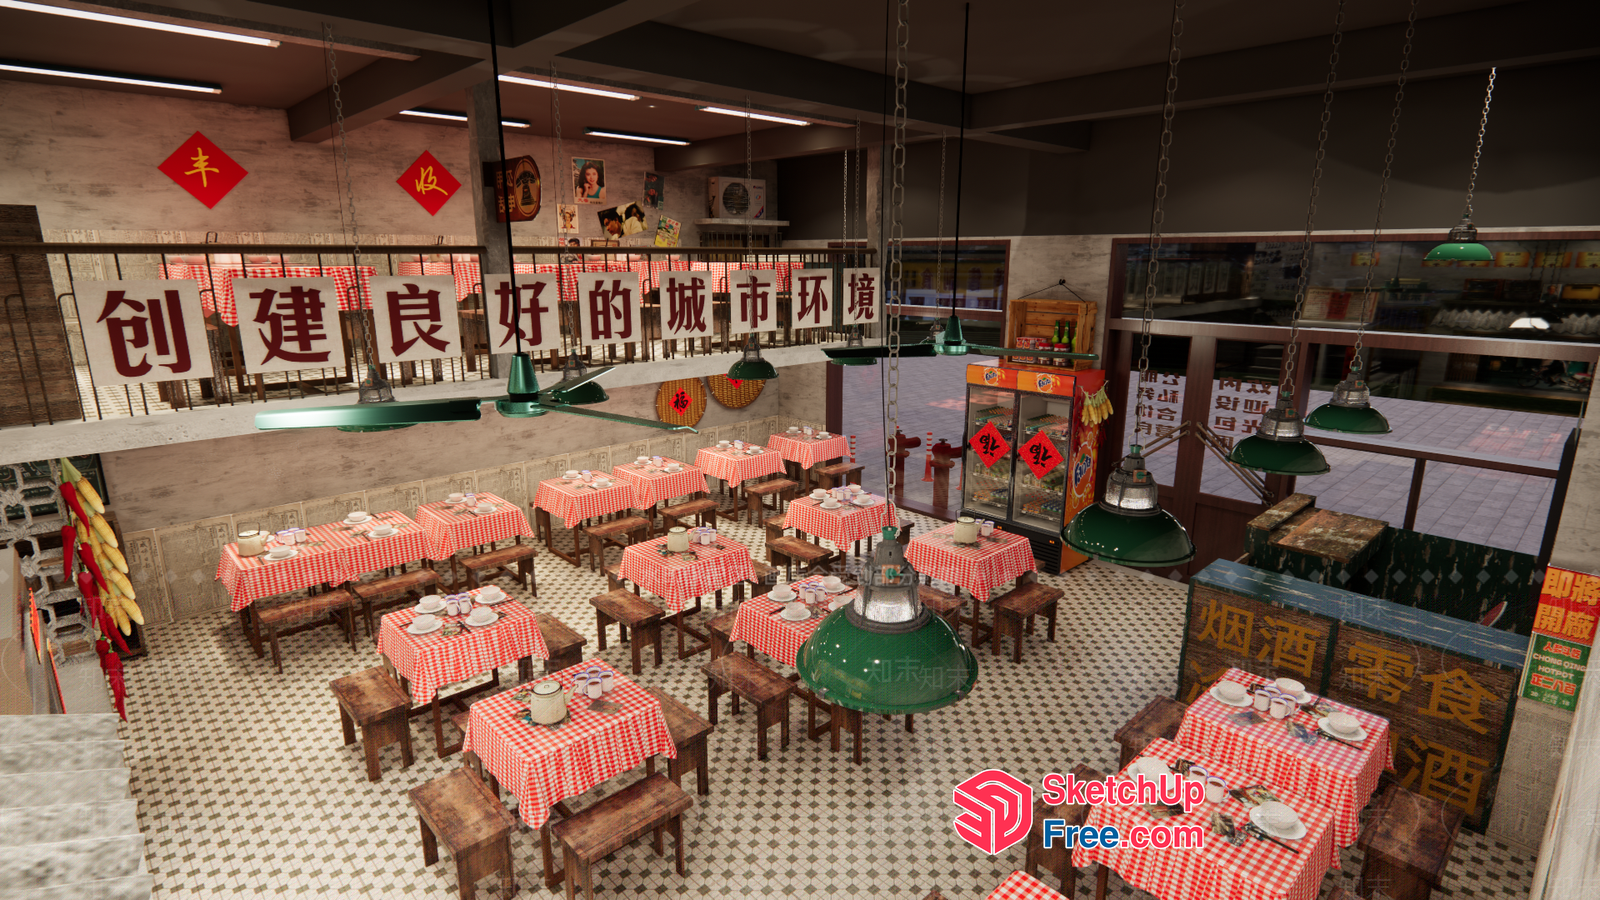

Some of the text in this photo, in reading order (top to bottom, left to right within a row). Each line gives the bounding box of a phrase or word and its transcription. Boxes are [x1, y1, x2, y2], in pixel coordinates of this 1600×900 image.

[184, 147, 220, 188] 丰
[673, 391, 689, 412] 福
[979, 433, 1000, 458] 福
[1029, 442, 1052, 468] 福
[1197, 598, 1321, 679] 烟酒
[1532, 652, 1587, 673] CHONG QING
[1537, 664, 1575, 680] HOTPOT
[1344, 641, 1499, 735] 零食
